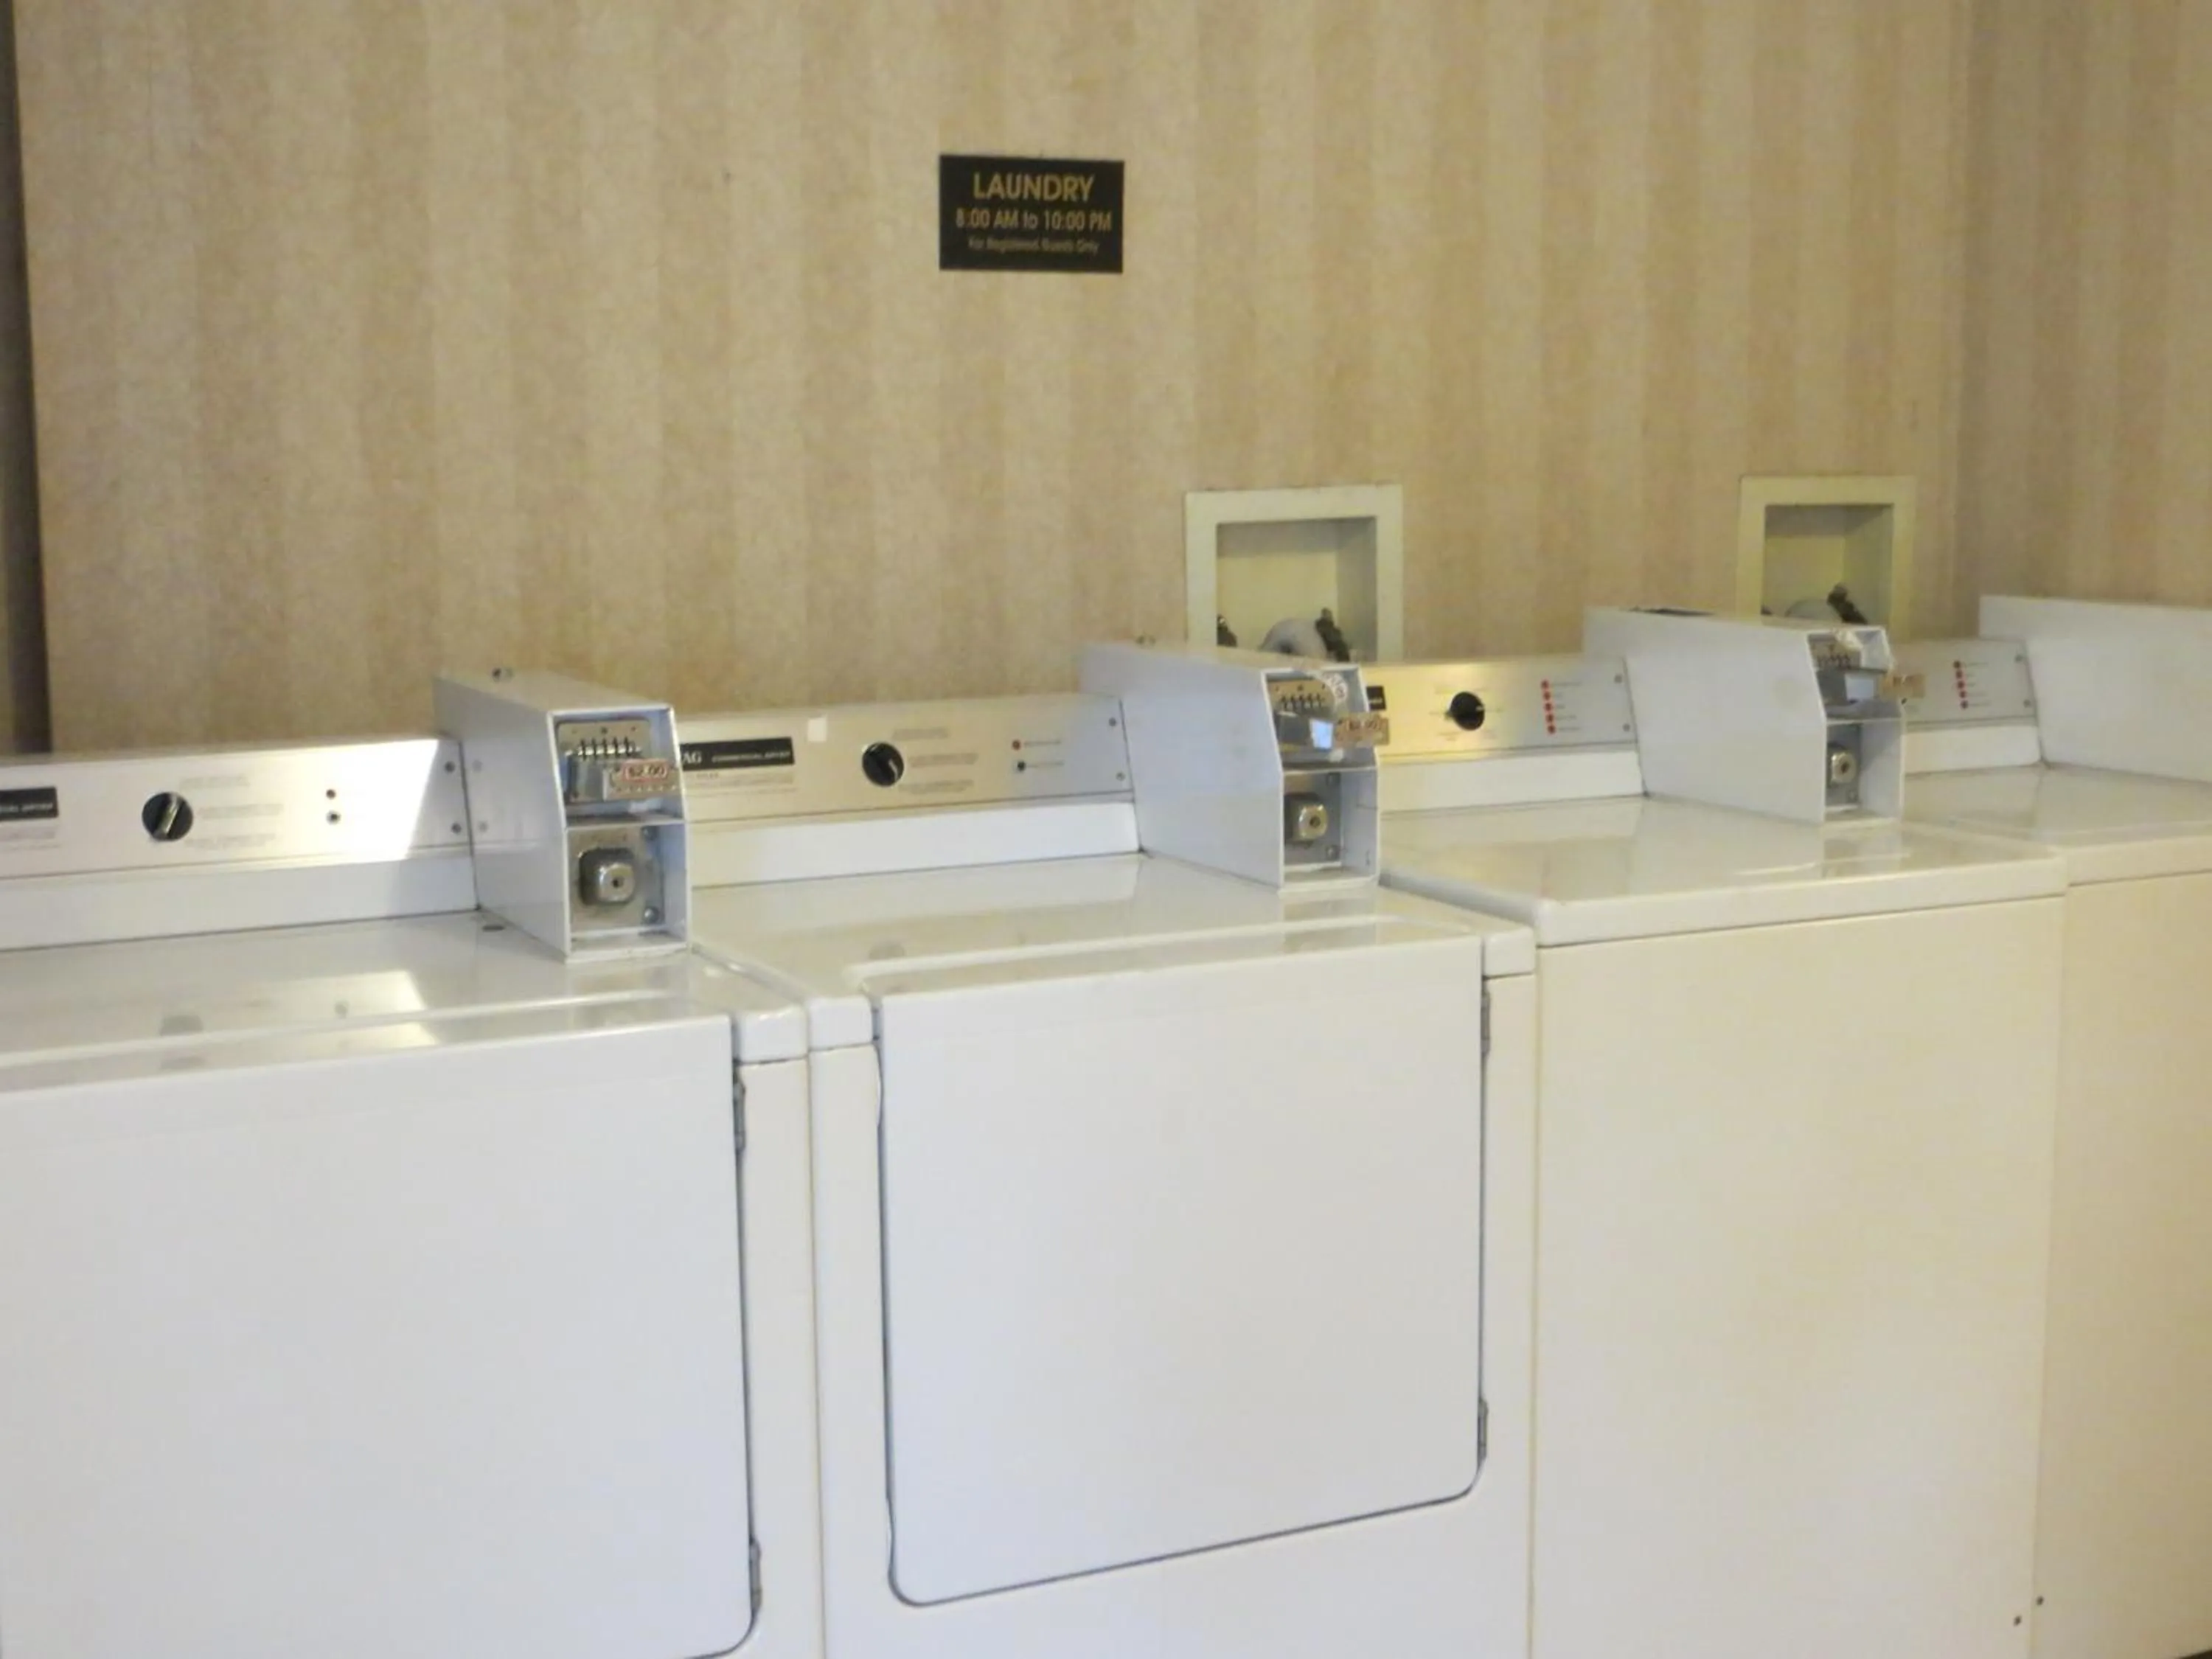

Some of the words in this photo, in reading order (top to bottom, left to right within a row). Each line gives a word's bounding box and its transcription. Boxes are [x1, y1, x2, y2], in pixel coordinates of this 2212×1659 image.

[973, 172, 1095, 202] LAUNDRY
[956, 207, 990, 229] 8:00
[993, 208, 1019, 229] AM
[1023, 209, 1038, 229] to
[1044, 209, 1085, 231] 10:00
[1089, 210, 1112, 232] PM
